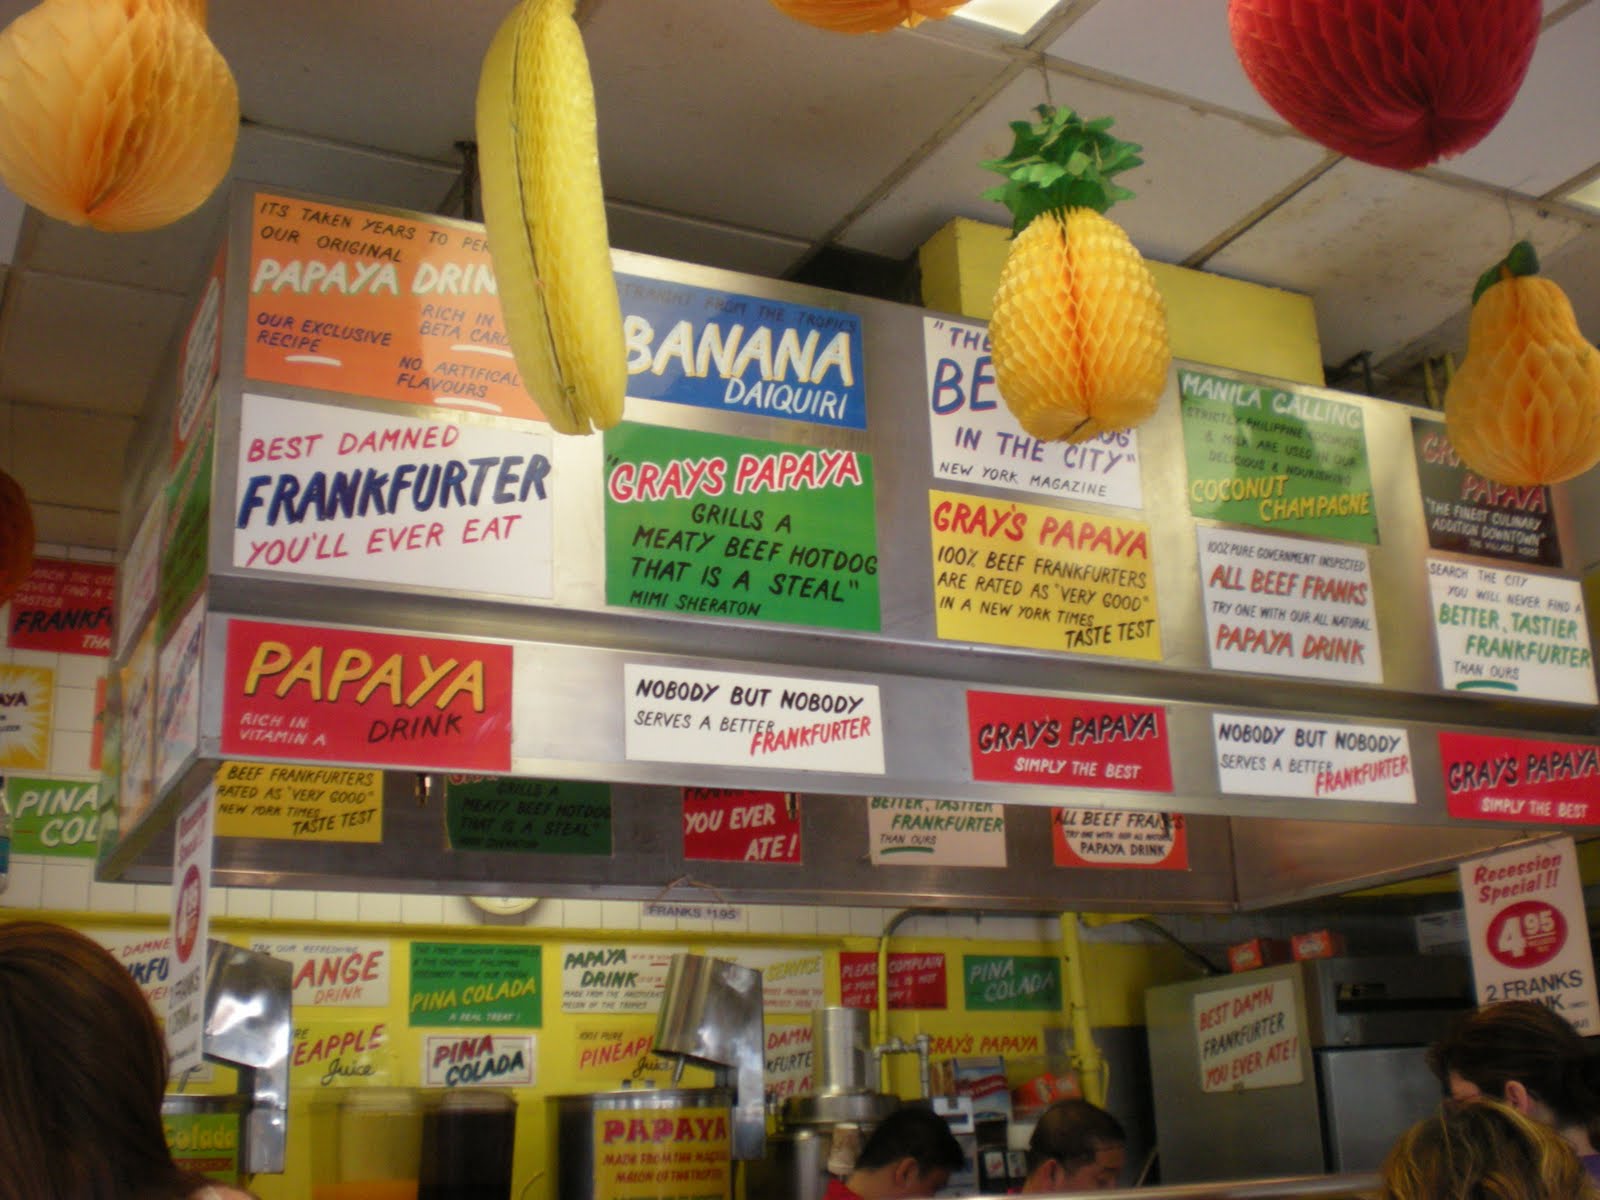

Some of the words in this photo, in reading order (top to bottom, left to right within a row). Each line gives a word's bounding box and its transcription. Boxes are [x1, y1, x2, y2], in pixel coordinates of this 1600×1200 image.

[260, 202, 289, 218] ITS
[302, 208, 352, 227] TAKEN
[362, 219, 416, 240] YEARS
[428, 231, 449, 246] TO
[260, 225, 300, 243] OUR
[317, 235, 402, 263] ORIGINAL
[252, 259, 399, 295] PAPAYA
[256, 312, 293, 330] OUR
[301, 319, 392, 346] EXCLUSIVE
[420, 321, 460, 339] BETA
[422, 304, 465, 322] RICH
[476, 313, 495, 327] IN
[256, 330, 321, 352] RECIPE
[623, 316, 854, 386] BANANA
[399, 356, 423, 370] NO
[397, 374, 488, 398] FLAVOURS
[724, 378, 848, 419] DAIQUIRI
[1182, 373, 1261, 408] MANILA
[1272, 393, 1361, 428] CALLING
[247, 434, 323, 462] BEST
[338, 425, 460, 455] DAMNED
[955, 426, 982, 451] IN
[997, 432, 1046, 462] THE
[733, 450, 863, 495] PAPAYA
[939, 461, 974, 476] NEW
[982, 466, 1018, 482] YORK
[1029, 475, 1107, 497] MAGAZINE
[236, 454, 551, 529] FRANKFURTER
[1191, 475, 1289, 502] COCONUT
[691, 503, 764, 531] GRILLS
[775, 514, 792, 534] A
[1259, 492, 1370, 522] CHAMPAGNE
[246, 532, 348, 567] YOU'LL
[366, 522, 445, 554] EVER
[461, 515, 522, 544] EAT
[933, 501, 1027, 542] GRAY'S
[1039, 516, 1148, 560] PAPAYA
[632, 525, 715, 553] MEATY
[724, 537, 783, 561] BEEF
[789, 545, 878, 575] HOTDOG
[1231, 544, 1255, 557] PURE
[1319, 555, 1366, 572] INSPECTED
[631, 557, 691, 582] THAT
[701, 566, 722, 588] IS
[732, 570, 750, 591] A
[938, 545, 979, 568] 100%
[985, 551, 1026, 572] BEEF
[1033, 558, 1146, 590] FRANKFURTERS
[1429, 563, 1468, 579] SEARCH
[1479, 570, 1496, 584] THE
[1504, 574, 1528, 587] CITY
[937, 572, 966, 590] ARE
[975, 578, 1022, 596] RATED
[1030, 583, 1049, 599] AS
[1209, 564, 1246, 591] ALL
[1250, 568, 1299, 596] BEEF
[1302, 575, 1367, 606] FRANKS
[1448, 586, 1468, 598] YOU
[1476, 590, 1500, 602] WILL
[1507, 594, 1541, 608] NEVER
[1547, 598, 1570, 613] FIND
[1575, 603, 1582, 614] A
[630, 591, 668, 607] MIMI
[676, 595, 762, 616] SHERATON
[940, 597, 954, 609] IN
[961, 599, 972, 610] A
[980, 601, 1013, 616] NEW
[1018, 605, 1051, 621] YORK
[1057, 611, 1095, 626] TIMES
[1212, 601, 1232, 614] TRY
[1235, 605, 1256, 617] ONE
[1260, 607, 1286, 621] WITH
[1065, 625, 1112, 649] TASTE
[1118, 619, 1155, 641] TEST
[1511, 612, 1578, 640] TASTIER
[1216, 623, 1294, 657] PAPAYA
[1302, 634, 1366, 665] DRINK
[1465, 634, 1591, 669] FRANKFURTER
[244, 640, 485, 713] PAPAYA
[1454, 661, 1483, 675] THAN
[1490, 666, 1520, 680] OURS
[635, 678, 720, 702] NOBODY
[730, 686, 772, 707] BUT
[780, 689, 863, 714] NOBODY
[240, 712, 282, 728] RICH
[290, 716, 308, 729] IN
[368, 714, 462, 743] DRINK
[634, 710, 691, 729] SERVES
[699, 715, 711, 731] A
[719, 717, 775, 734] BETTER
[978, 716, 1062, 754] GRAY'S
[1069, 712, 1159, 746] PAPAYA
[239, 729, 306, 745] VITAMIN
[312, 734, 327, 746] A
[749, 716, 871, 756] FRANKFURTER
[1219, 723, 1285, 744] NOBODY
[1295, 728, 1328, 748] BUT
[1335, 731, 1401, 752] NOBODY
[227, 766, 264, 780] BEEF
[270, 768, 374, 786] FRANKFURTERS
[1014, 757, 1067, 774] SIMPLY
[1072, 761, 1098, 777] THE
[1105, 763, 1142, 779] BEST
[1220, 754, 1266, 771] SERVES
[1272, 758, 1282, 770] A
[1289, 758, 1333, 774] BETTER
[1314, 755, 1409, 796] FRANKFURTER
[1526, 745, 1600, 784] PAPAYA
[16, 785, 98, 818] PINA
[217, 785, 258, 798] RATED
[264, 788, 281, 800] AS
[1481, 797, 1526, 814] SIMPLY
[1529, 801, 1551, 816] THE
[1558, 803, 1588, 818] BEST
[219, 803, 247, 814] NEW
[252, 806, 281, 816] YORK
[287, 806, 320, 817] TIMES
[292, 816, 335, 836] TASTE
[341, 809, 377, 827] TEST
[685, 809, 724, 835] YOU
[729, 803, 776, 830] EVER
[891, 815, 1004, 832] FRANKFURTER
[1082, 812, 1123, 826] BEEF
[880, 834, 905, 843] THAN
[1081, 842, 1125, 855] PAPAYA
[1130, 844, 1165, 856] DRINK
[1474, 855, 1562, 885] Recession
[647, 905, 701, 918] FRANKS
[564, 949, 627, 970] PAPAYA
[970, 959, 1015, 985] PINA
[315, 984, 363, 1005] DRINK
[580, 971, 639, 988] DRINK
[984, 972, 1055, 1002] COLADA
[1486, 986, 1497, 1002] 2
[1504, 970, 1583, 1000] FRANKS
[411, 988, 457, 1013] PINA
[462, 977, 536, 1006] COLADA
[1200, 1002, 1230, 1032] BEST
[1232, 984, 1274, 1019] DAMN
[433, 1035, 493, 1067] PINA
[980, 1036, 1038, 1053] PAPAYA
[1203, 1012, 1285, 1060] FRANKFURTER
[446, 1051, 524, 1087] COLADA
[1205, 1063, 1229, 1088] YOU
[1232, 1051, 1262, 1080] EVER
[603, 1116, 727, 1145] PAPAYA
